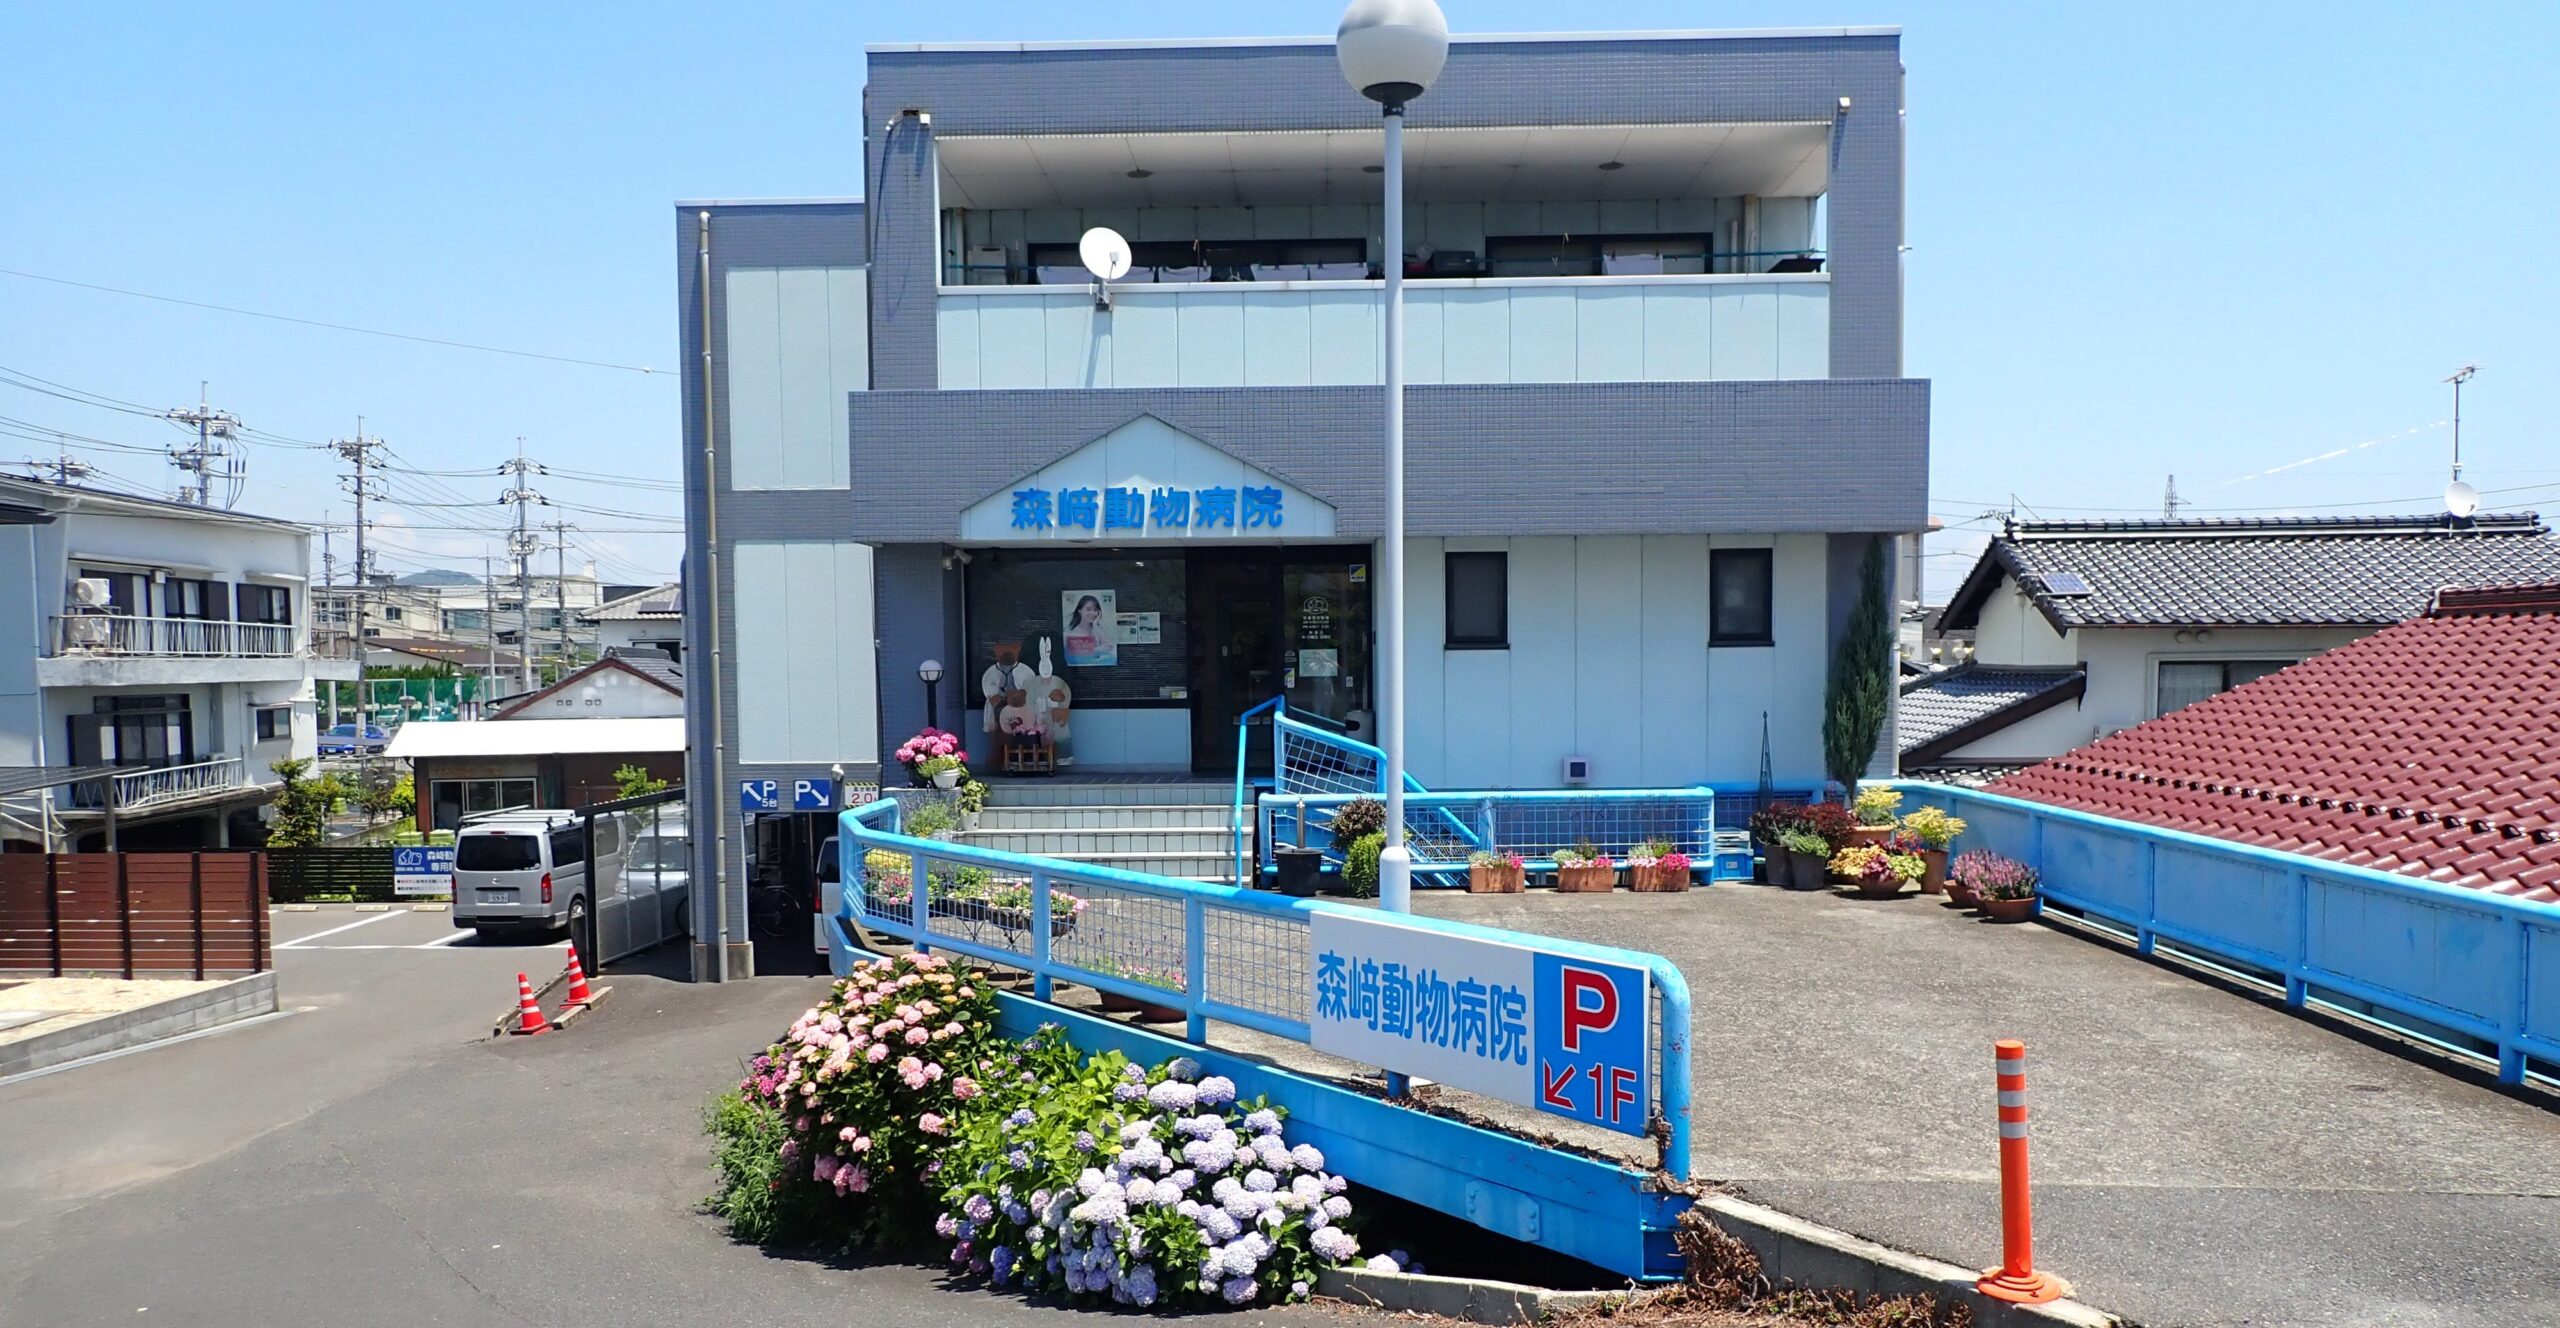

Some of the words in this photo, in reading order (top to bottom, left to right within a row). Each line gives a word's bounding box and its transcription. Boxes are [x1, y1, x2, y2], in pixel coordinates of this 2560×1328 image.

[763, 780, 776, 797] P
[794, 780, 811, 802] P
[762, 797, 778, 808] 5台
[1561, 965, 1620, 1054] P
[1587, 1062, 1637, 1124] 1F
